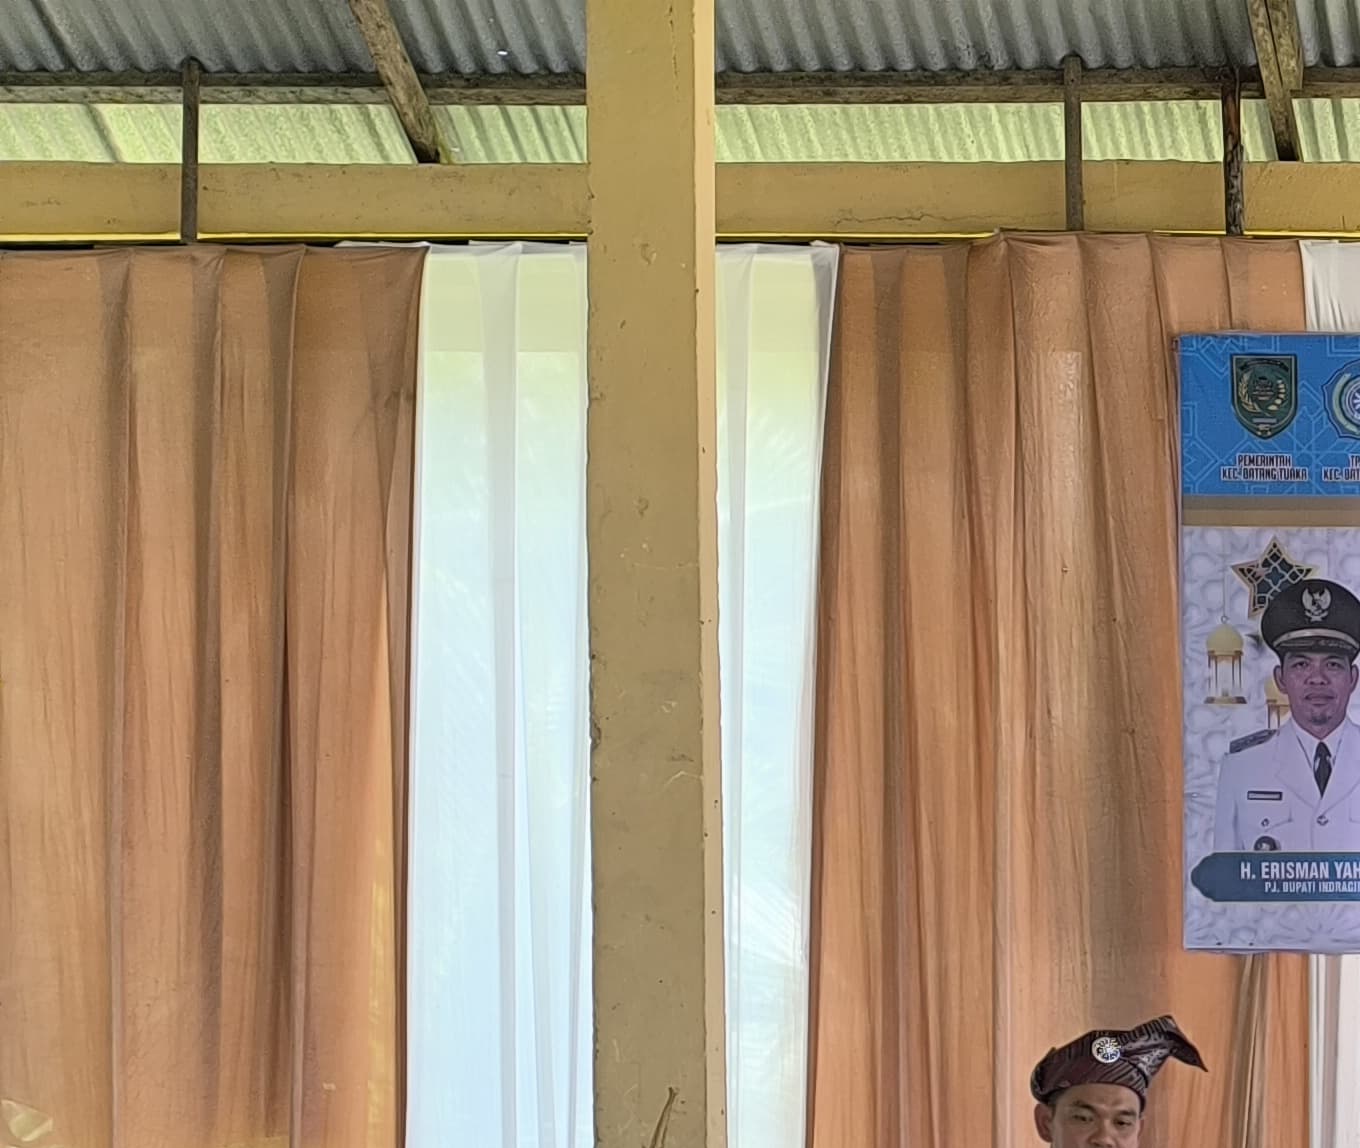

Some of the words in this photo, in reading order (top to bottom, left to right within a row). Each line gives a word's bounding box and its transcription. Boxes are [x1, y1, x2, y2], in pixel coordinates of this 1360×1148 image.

[1240, 861, 1256, 880] H.
[1261, 861, 1329, 880] ERISMAN
[1282, 881, 1316, 893] BUPATI
